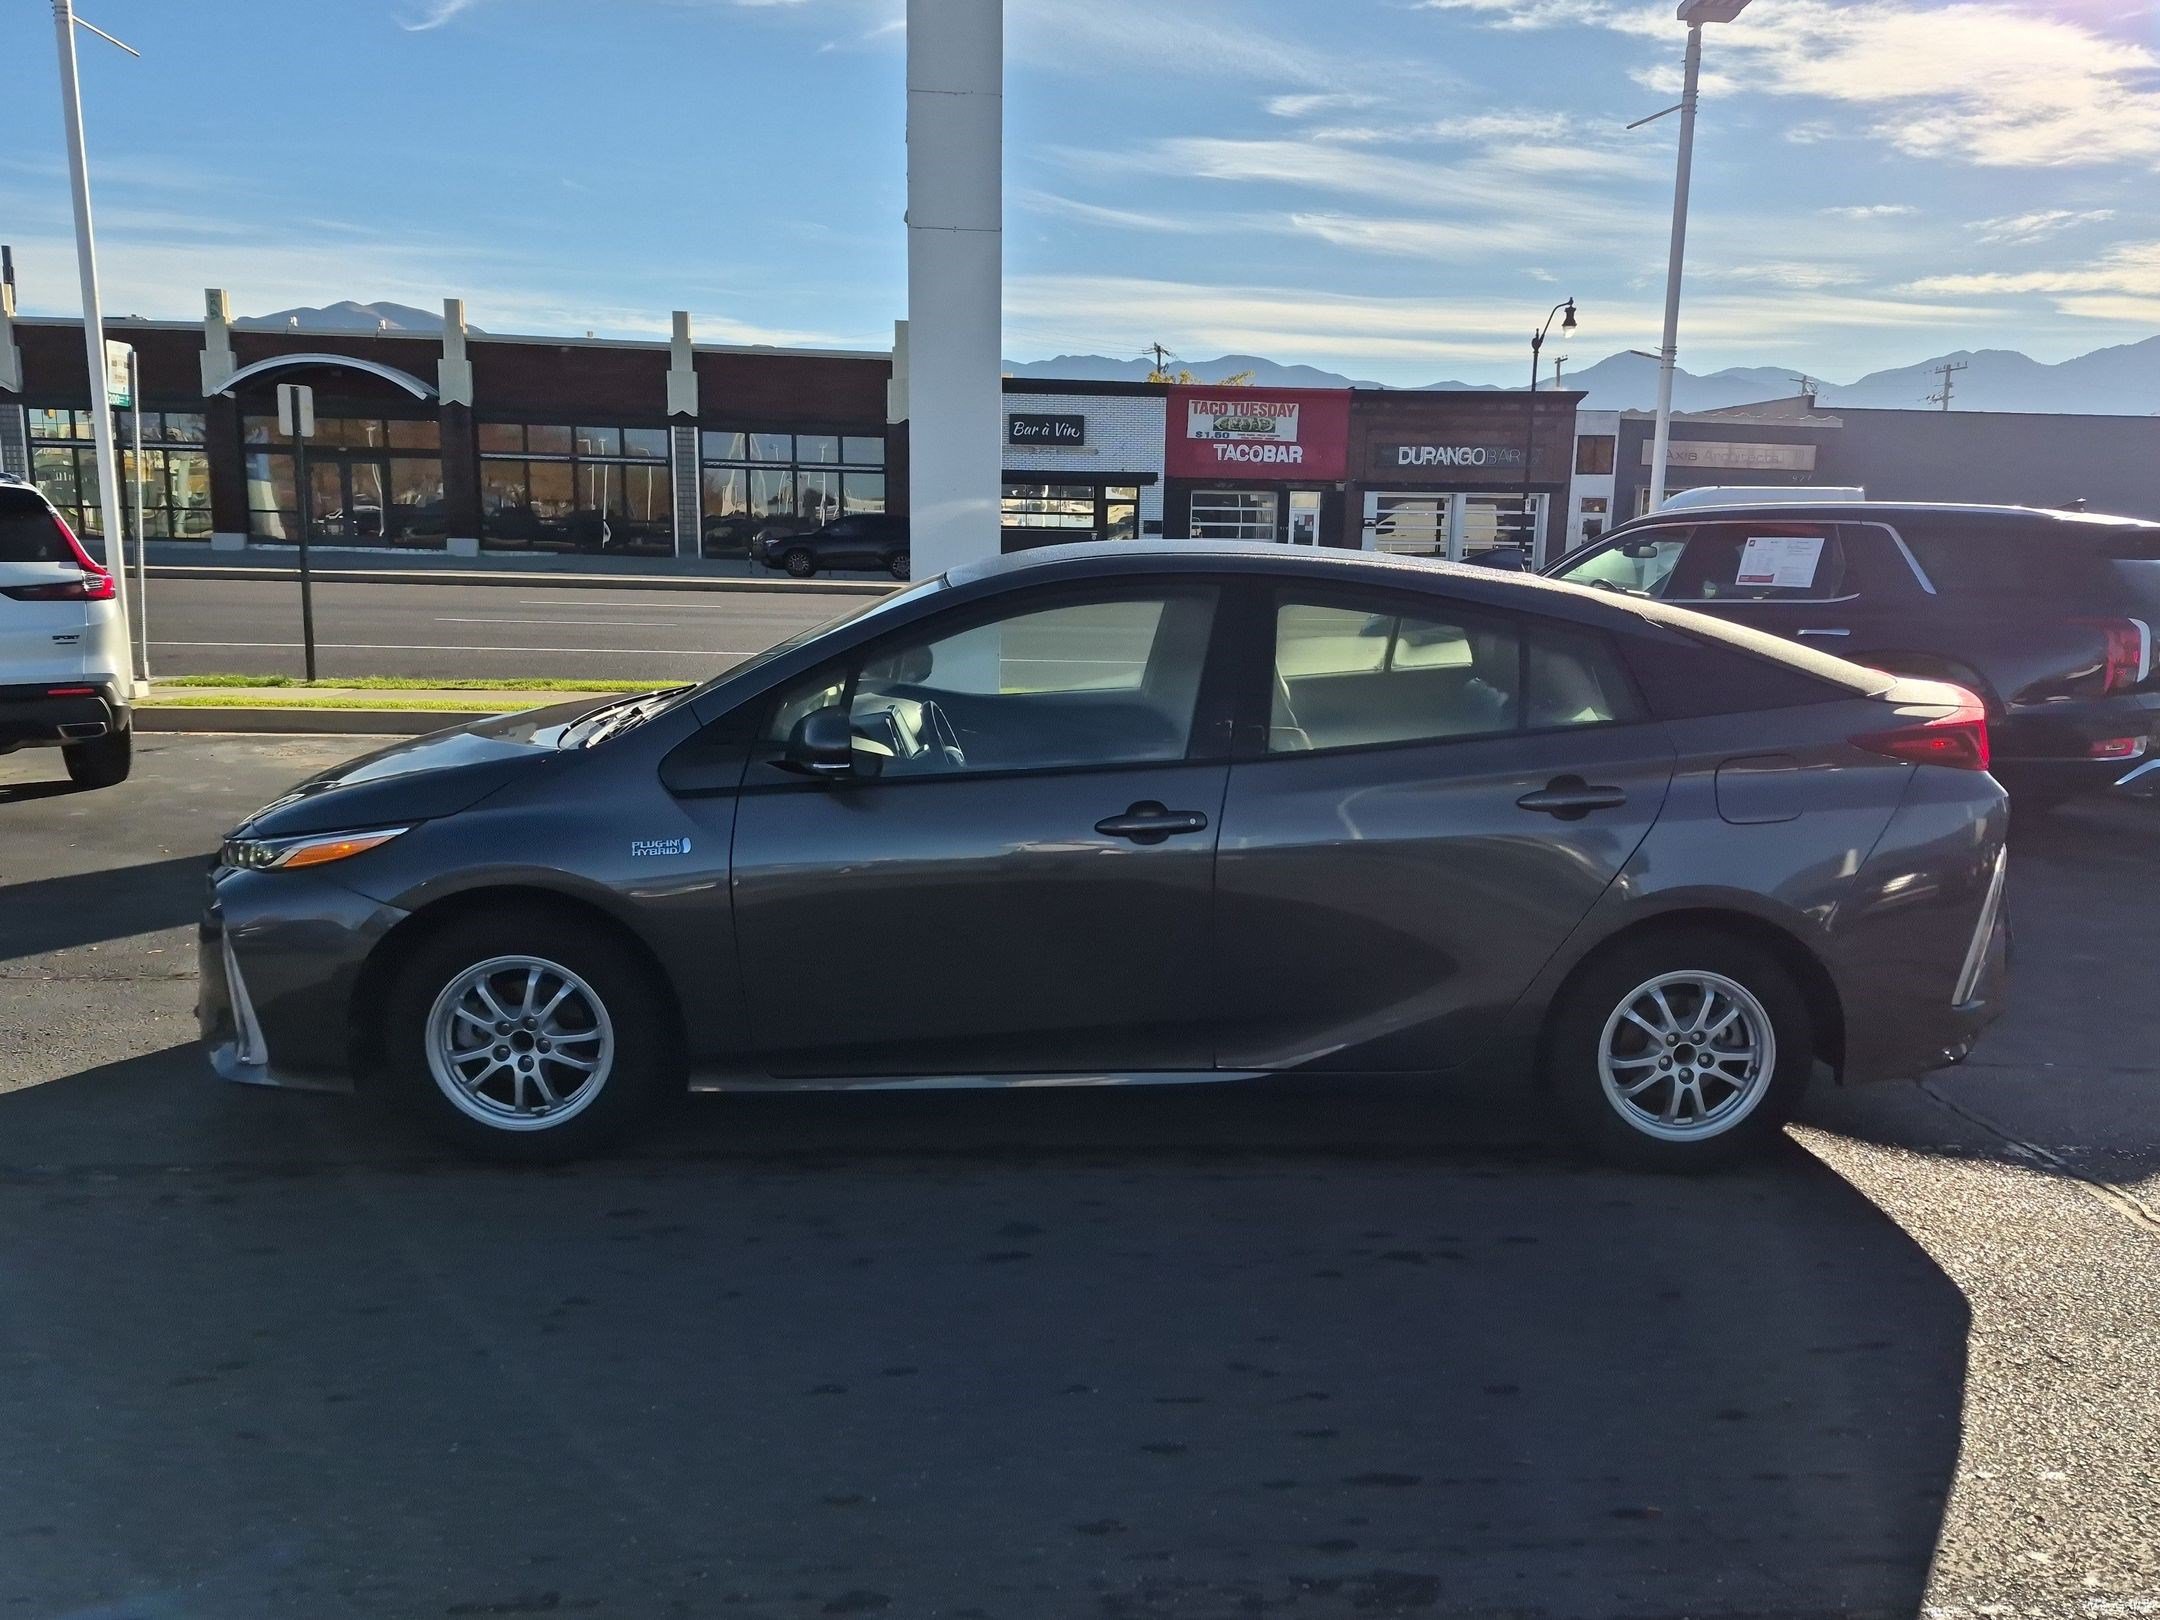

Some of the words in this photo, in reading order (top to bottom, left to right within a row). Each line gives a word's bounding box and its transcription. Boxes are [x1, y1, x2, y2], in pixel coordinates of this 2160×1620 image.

[1191, 401, 1228, 416] TACO
[1231, 403, 1296, 418] TUESDAY
[1013, 421, 1039, 436] Bar
[1041, 422, 1050, 436] à
[1055, 422, 1080, 438] Vin
[1195, 431, 1230, 439] $1.50
[631, 839, 680, 849] PLUG-IN
[631, 847, 680, 856] HYBRID
